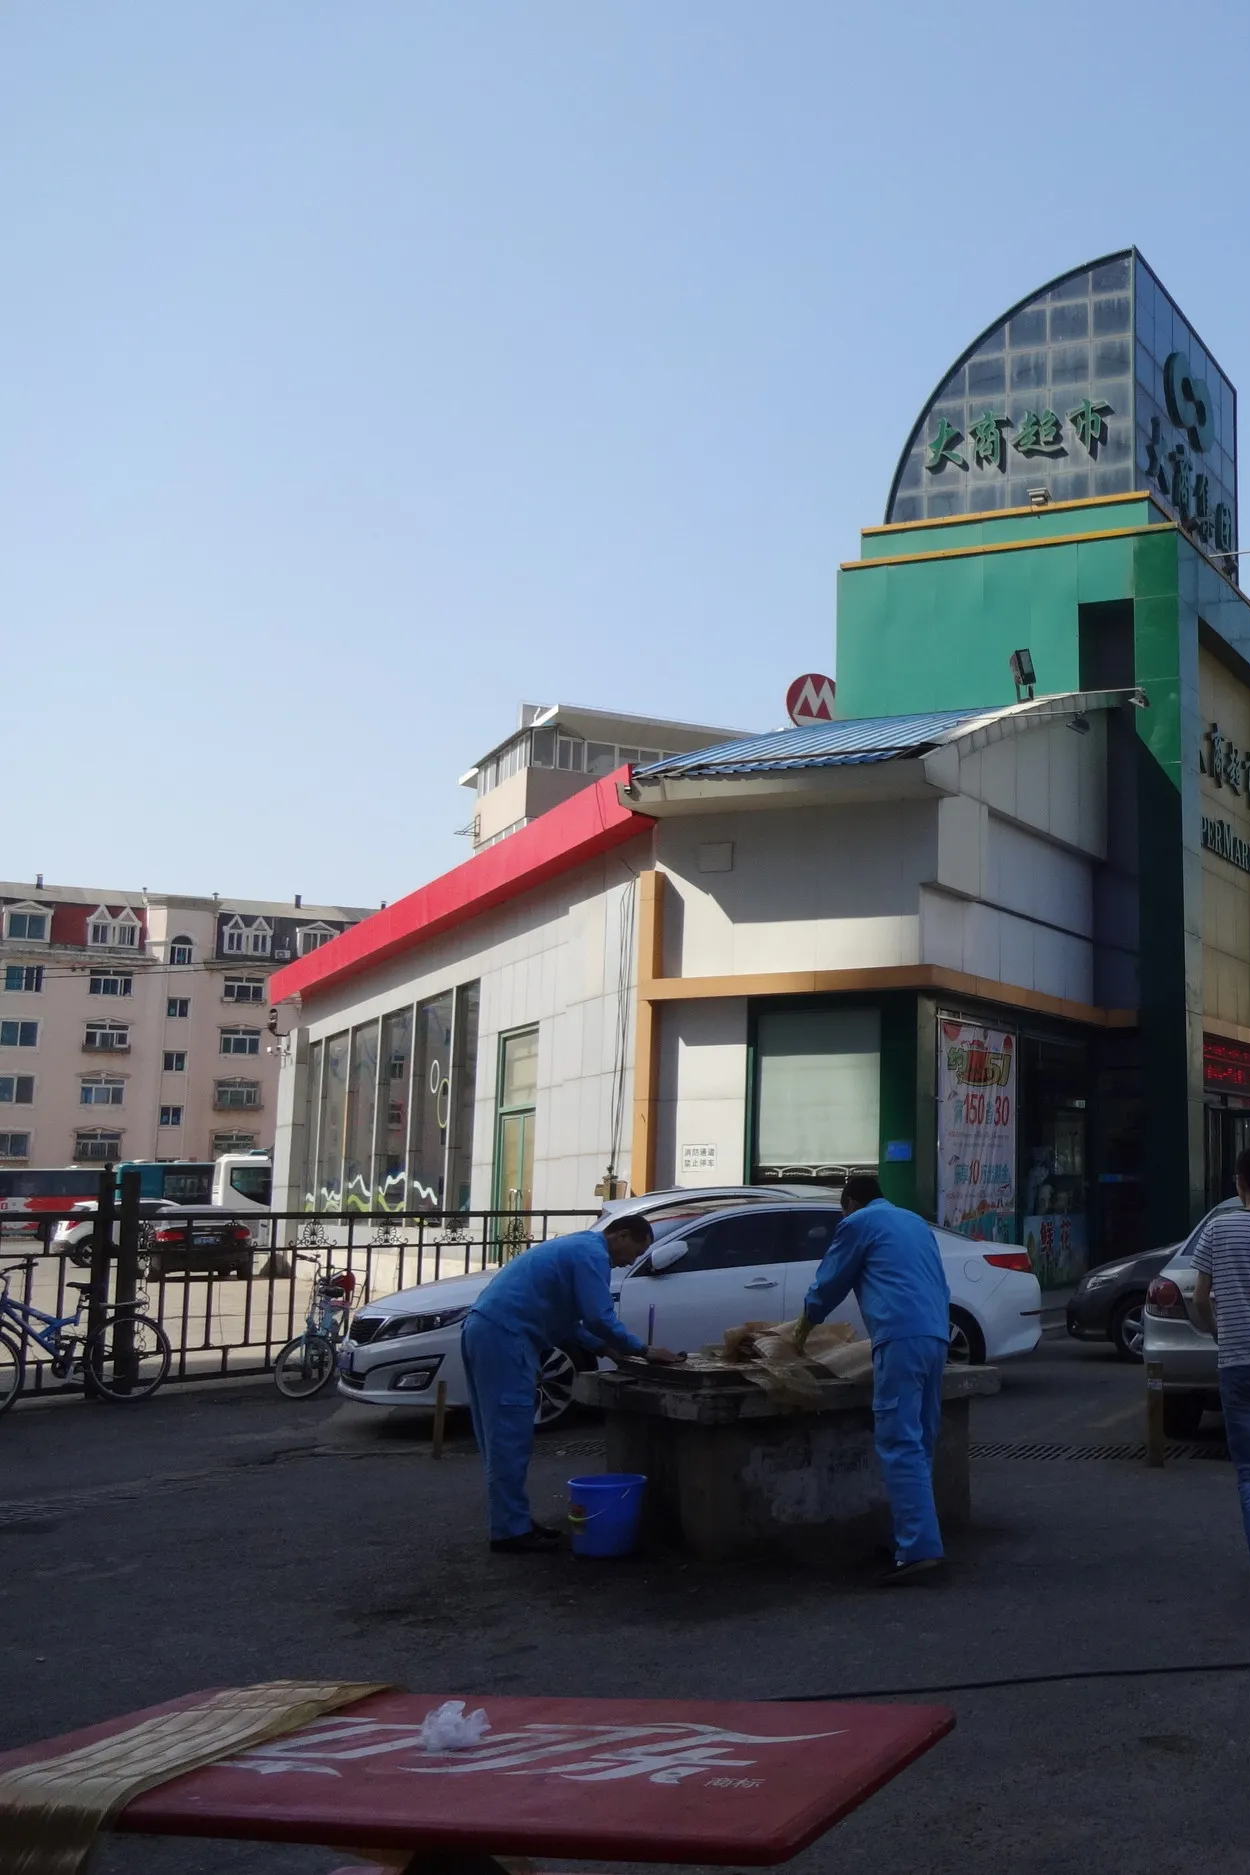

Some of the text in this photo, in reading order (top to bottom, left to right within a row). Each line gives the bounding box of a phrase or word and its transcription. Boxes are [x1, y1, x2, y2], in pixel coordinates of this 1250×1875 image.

[925, 399, 1111, 471] 大商超市
[684, 1148, 715, 1157] 消防通道
[684, 1159, 715, 1168] 禁止停车
[703, 1776, 767, 1788] 商标
